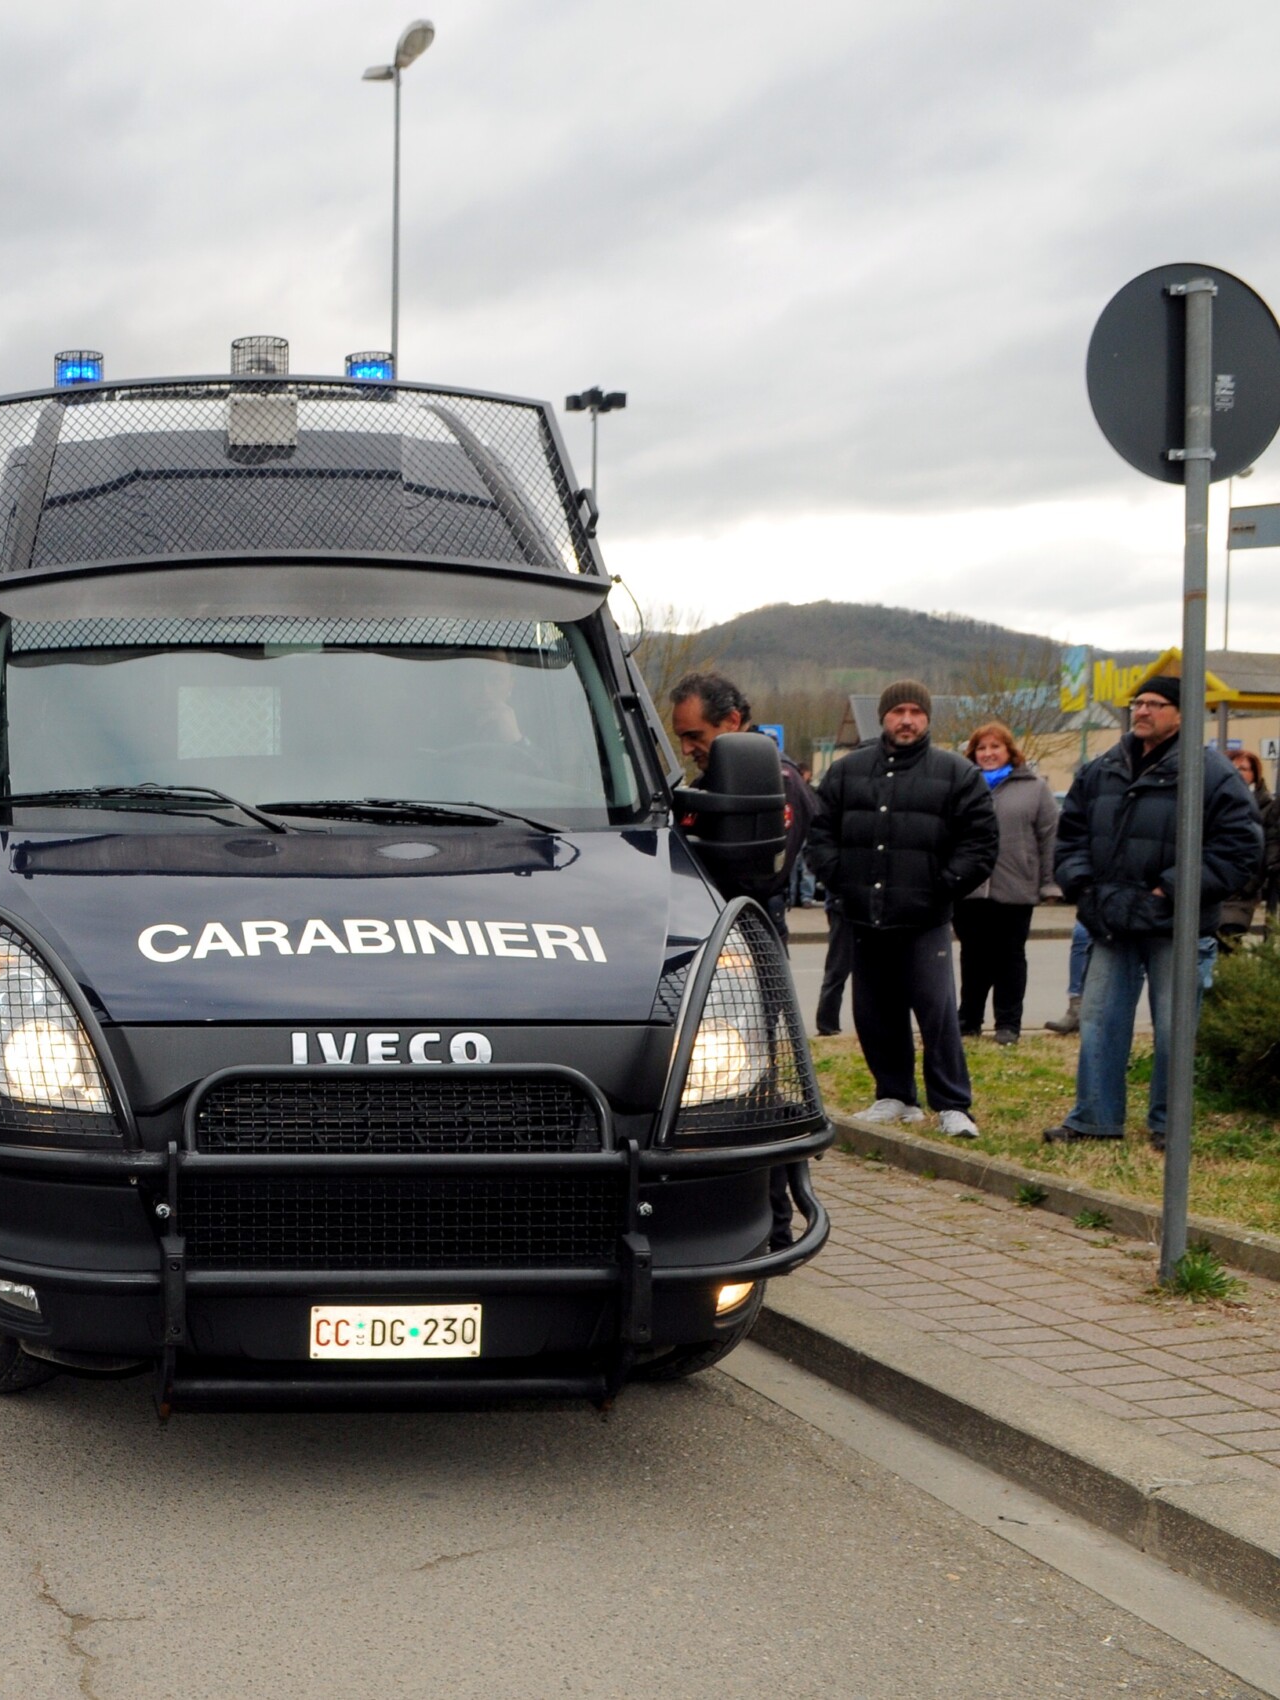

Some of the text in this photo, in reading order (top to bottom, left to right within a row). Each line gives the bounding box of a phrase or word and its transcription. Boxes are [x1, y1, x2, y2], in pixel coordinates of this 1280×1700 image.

[137, 919, 608, 963] CARABINIERI
[291, 1032, 493, 1065] IVECO
[315, 1317, 477, 1347] CC DG 230
